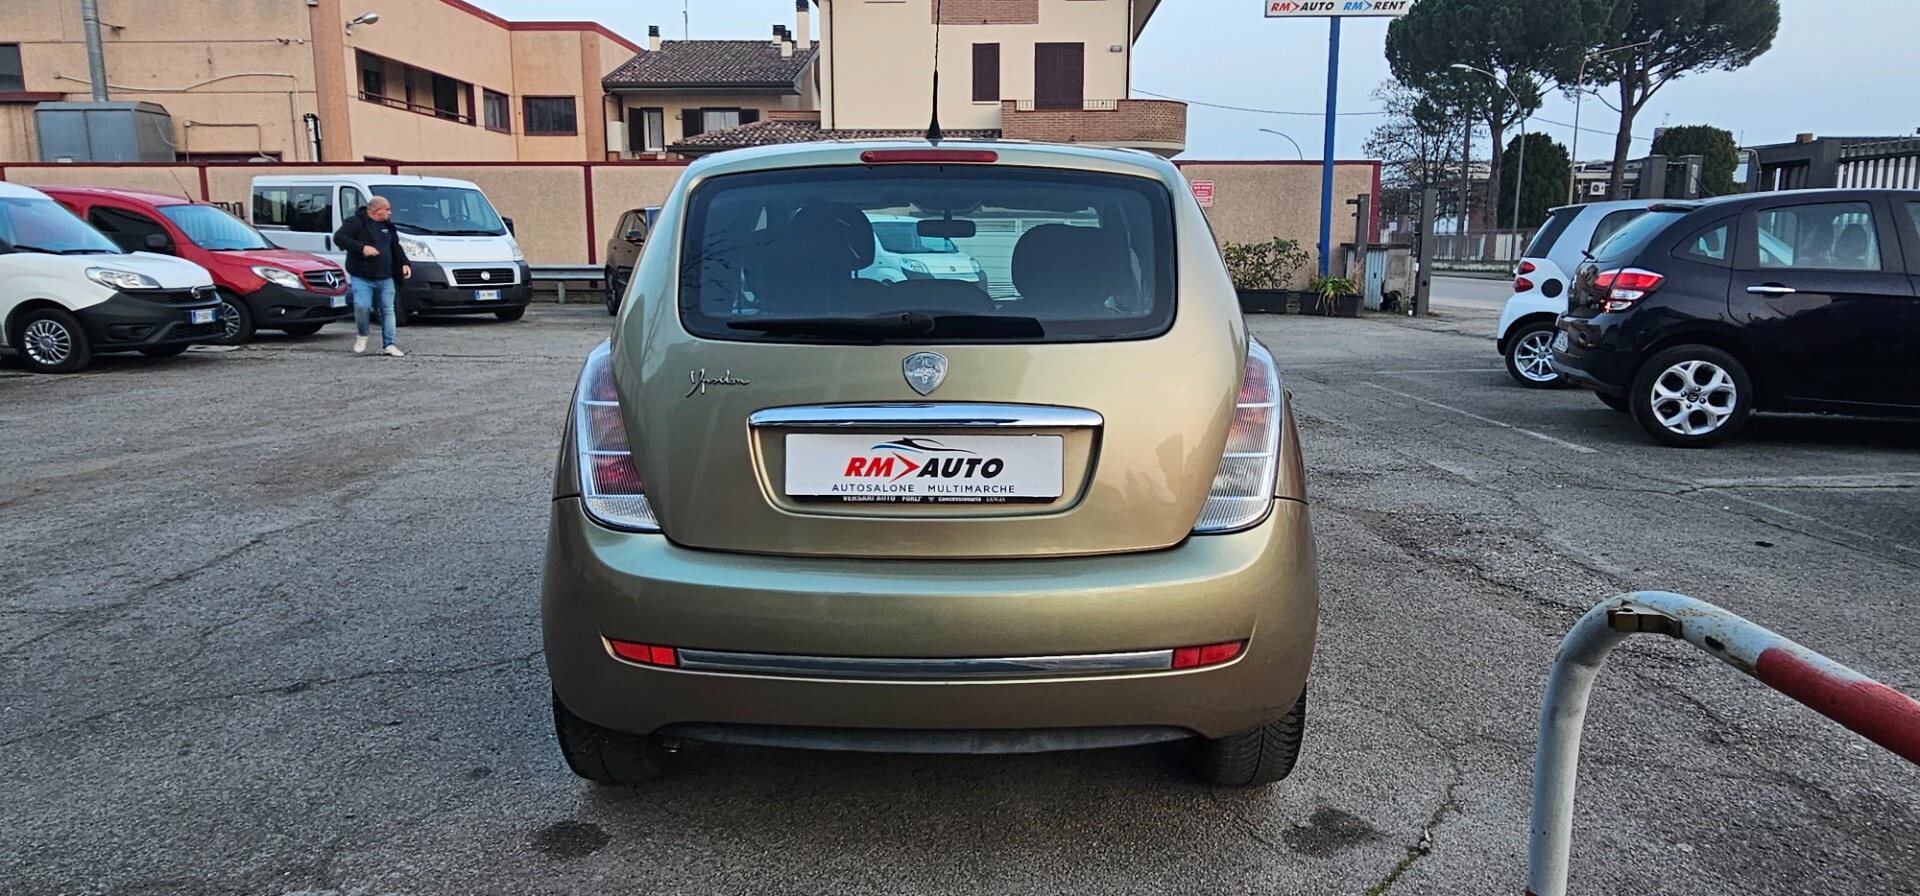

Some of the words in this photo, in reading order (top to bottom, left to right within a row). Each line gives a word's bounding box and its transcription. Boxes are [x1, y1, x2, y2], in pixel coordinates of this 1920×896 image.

[1299, 2, 1335, 12] AUTO
[1373, 1, 1407, 11] RENT
[686, 368, 751, 398] Ypsilon
[916, 457, 1004, 479] AUTO
[832, 484, 914, 492] AUTOSALONE
[928, 485, 1015, 493] MULTIMARCHE
